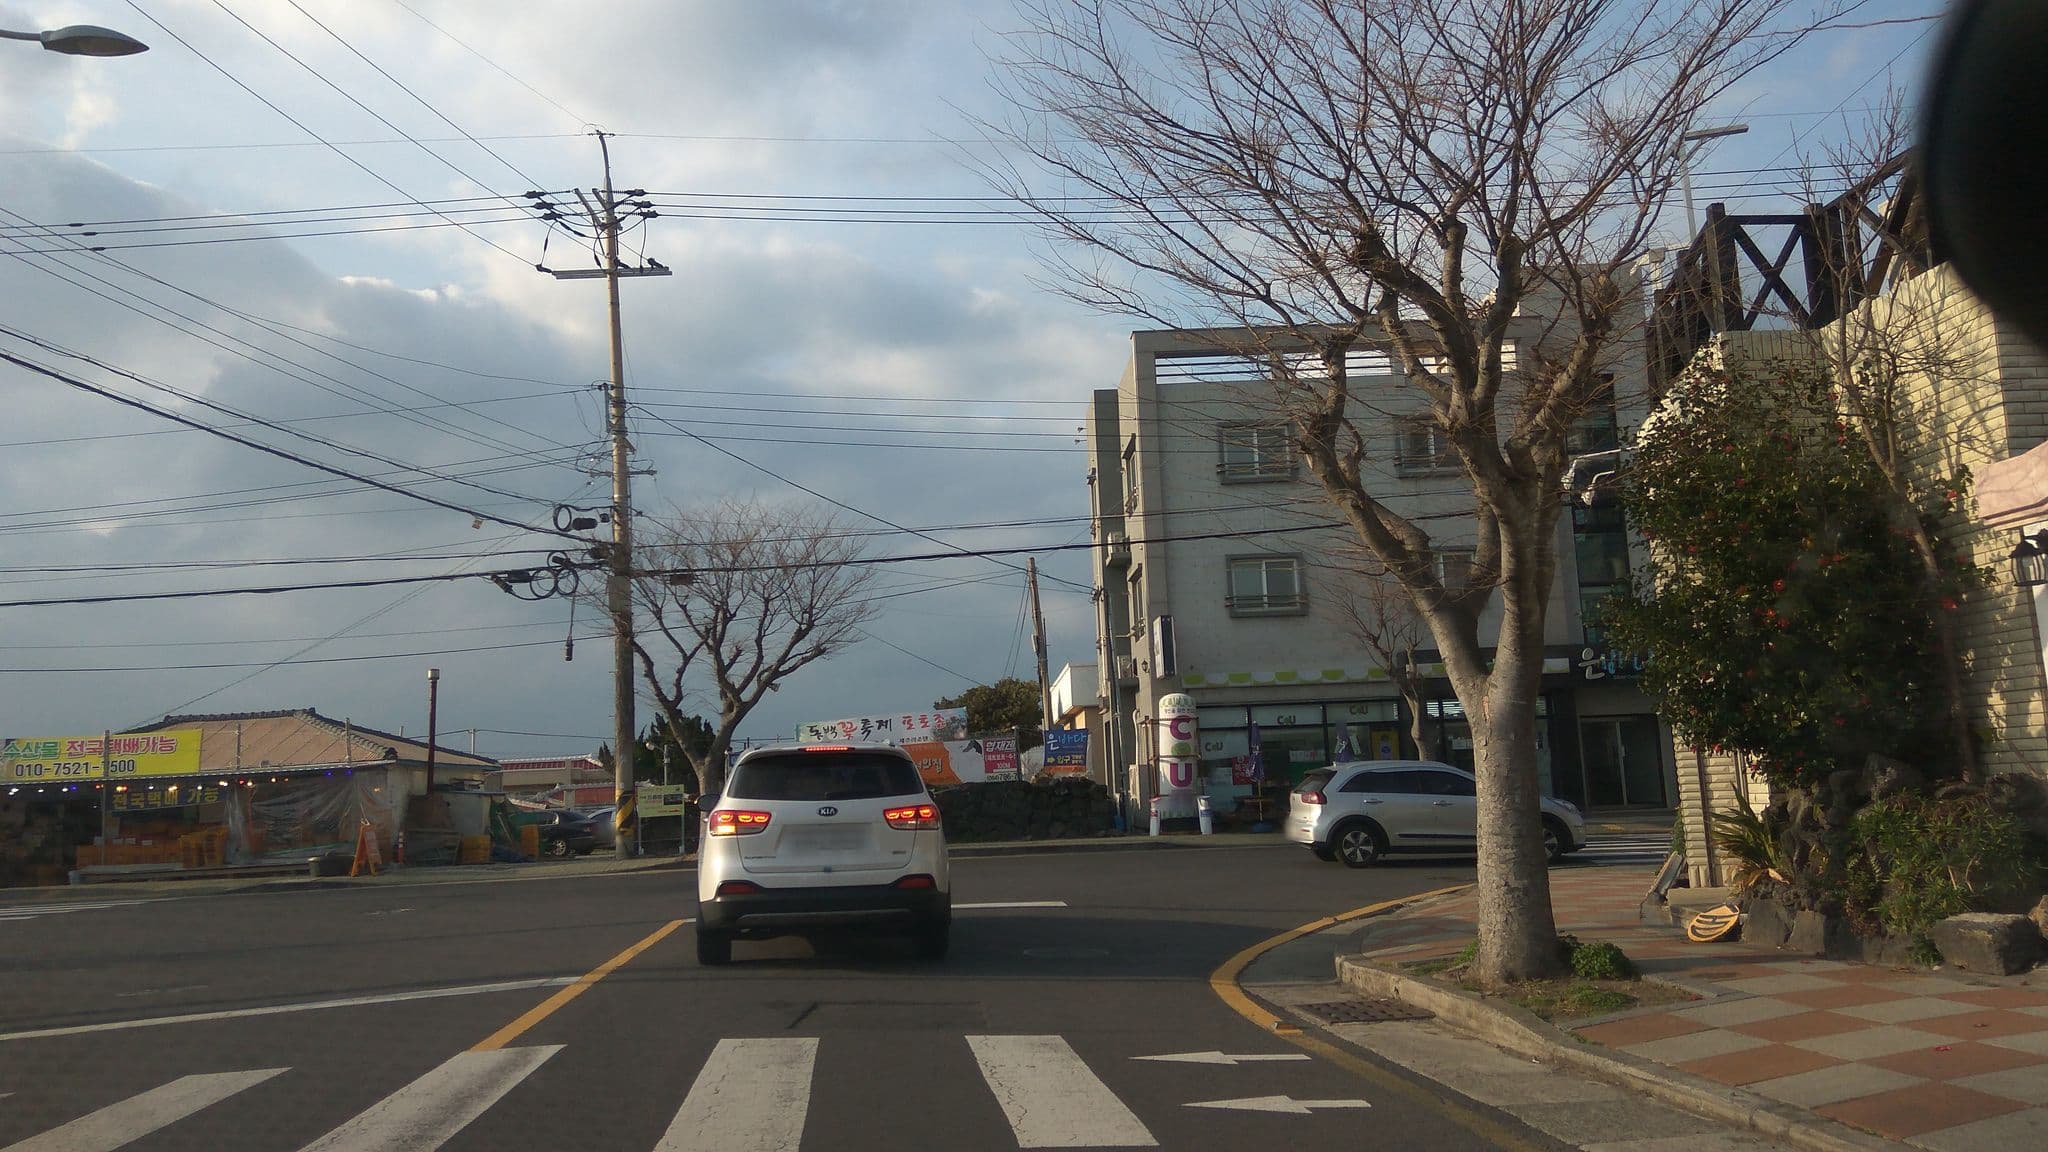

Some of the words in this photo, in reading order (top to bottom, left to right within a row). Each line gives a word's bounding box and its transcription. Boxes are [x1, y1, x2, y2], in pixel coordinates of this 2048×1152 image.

[3, 740, 60, 760] 수산물
[66, 735, 179, 759] 전국택배가능
[818, 806, 837, 817] KIA
